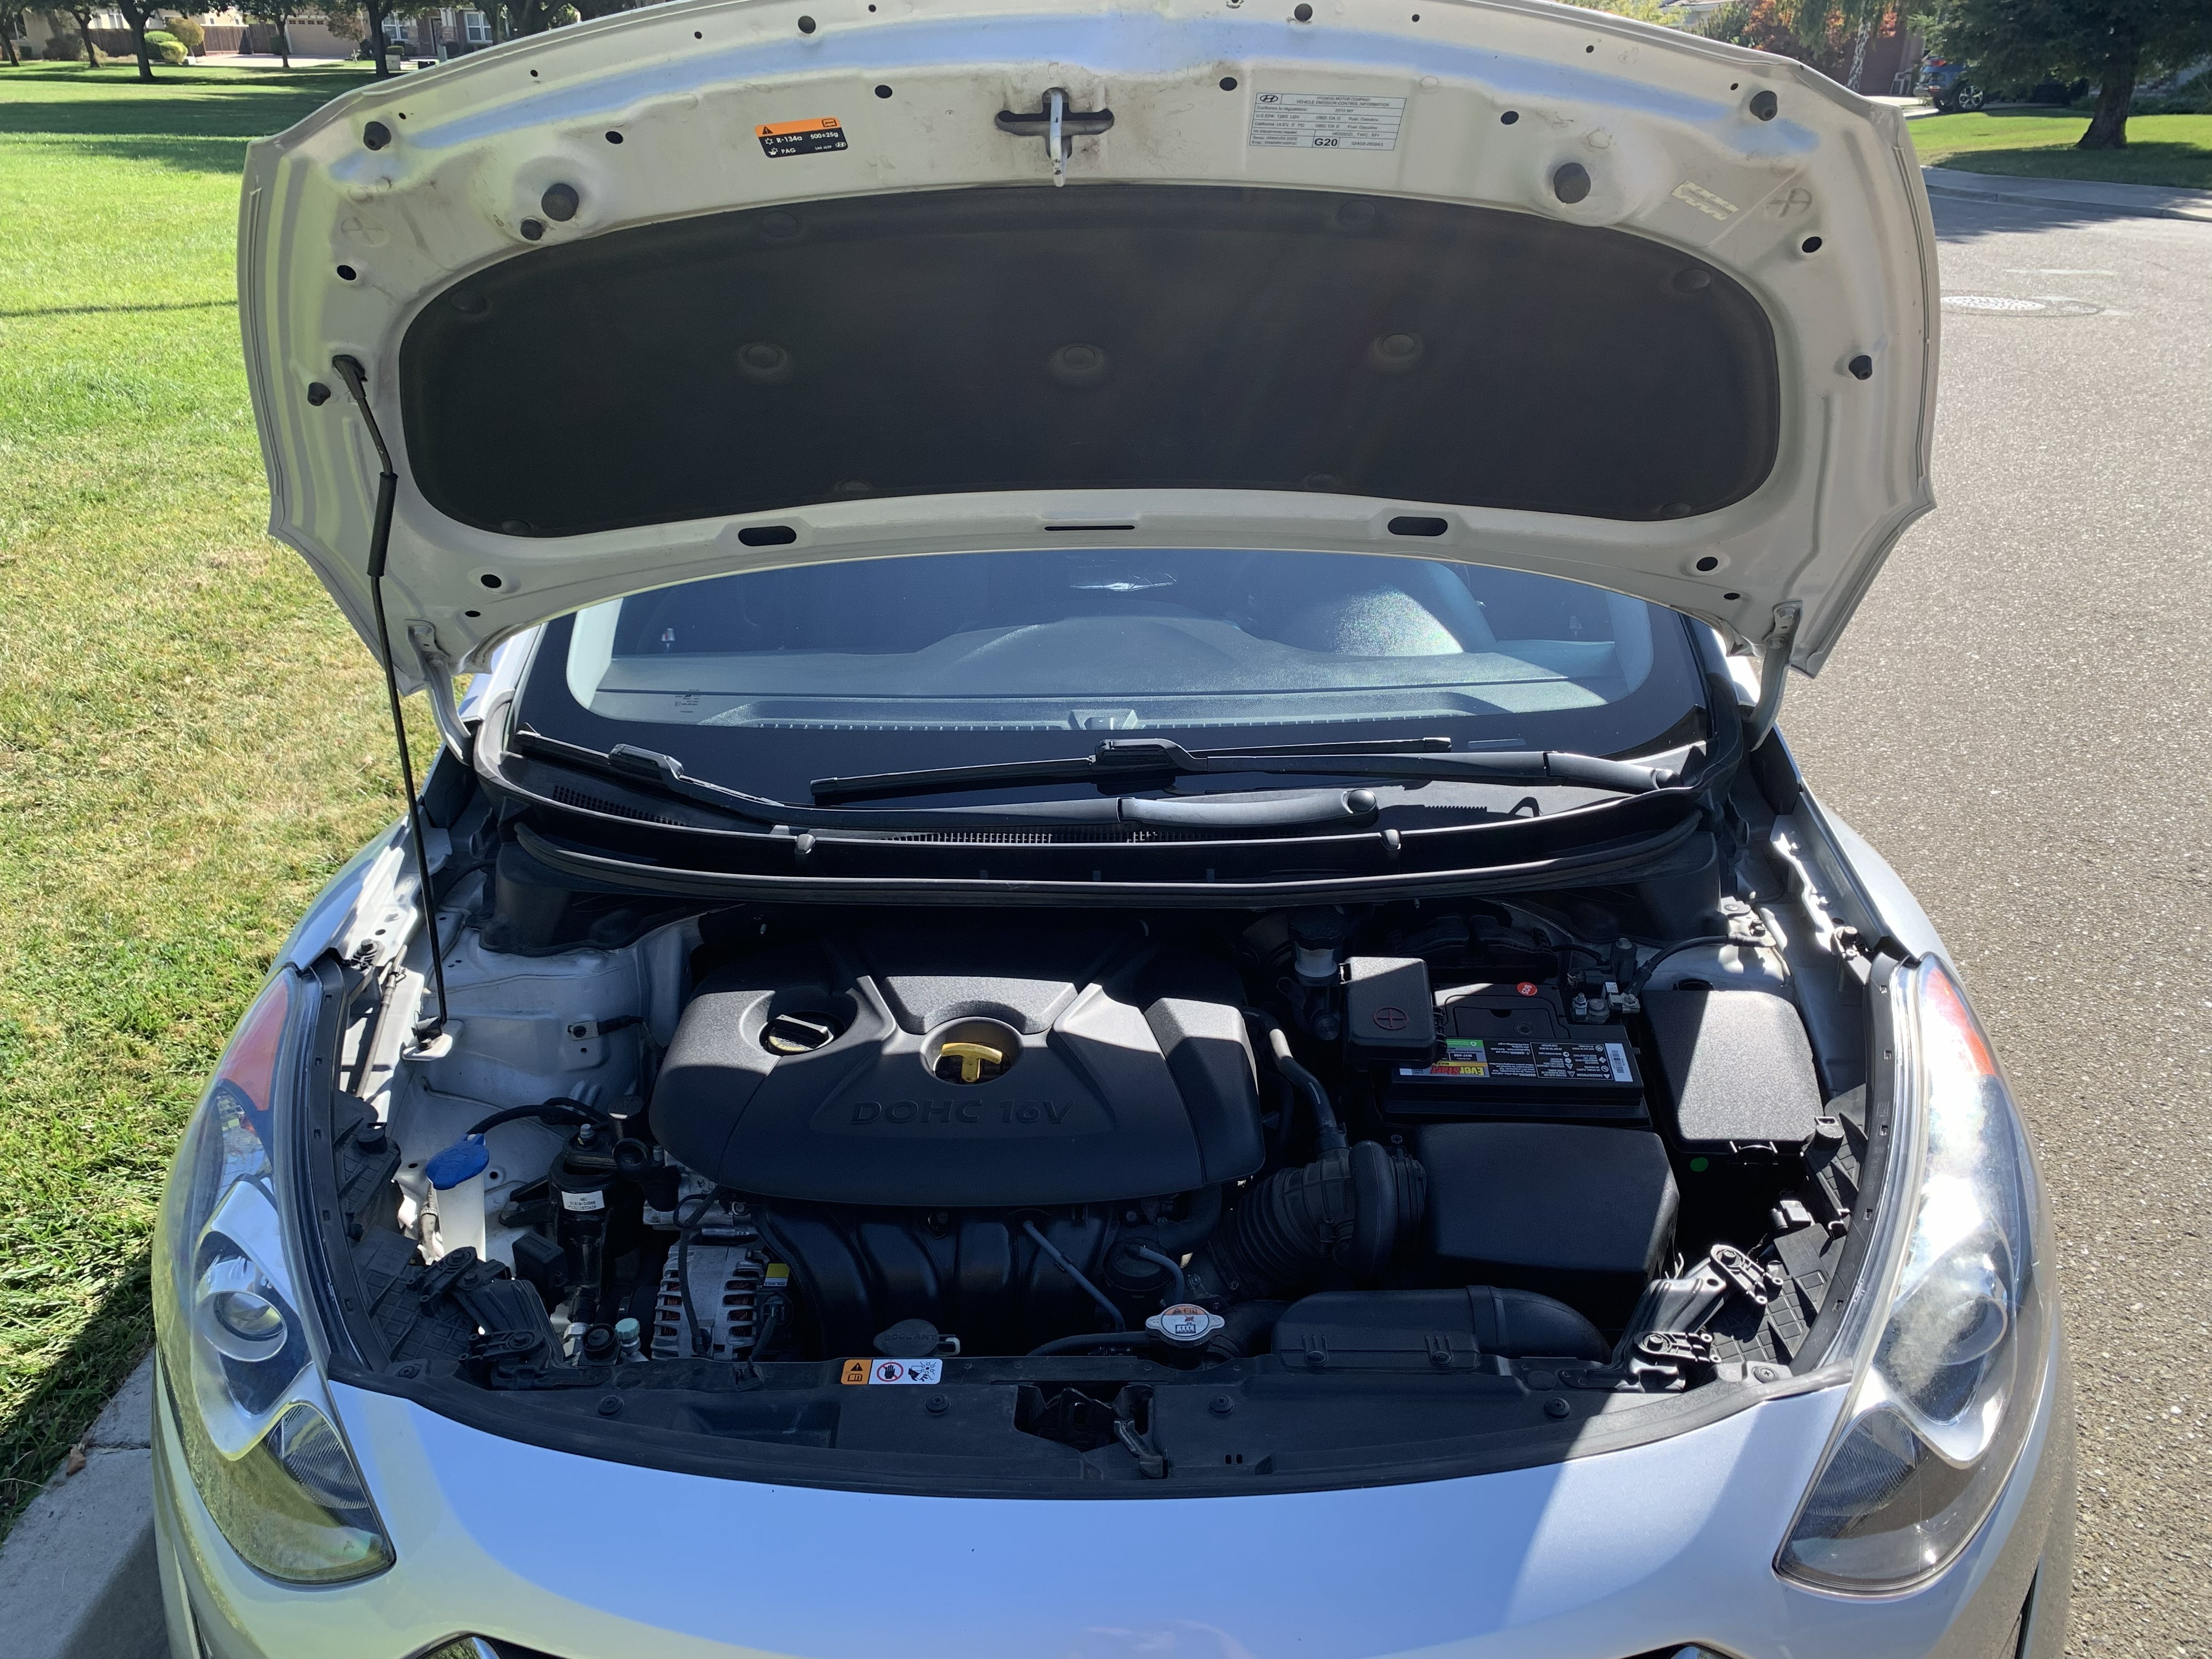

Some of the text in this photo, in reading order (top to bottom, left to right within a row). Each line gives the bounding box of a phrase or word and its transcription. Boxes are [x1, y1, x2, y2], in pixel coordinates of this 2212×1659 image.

[1431, 1066, 1485, 1076] EverStart
[851, 1099, 1076, 1125] DOHC 16V
[884, 1333, 937, 1341] COOLANT
